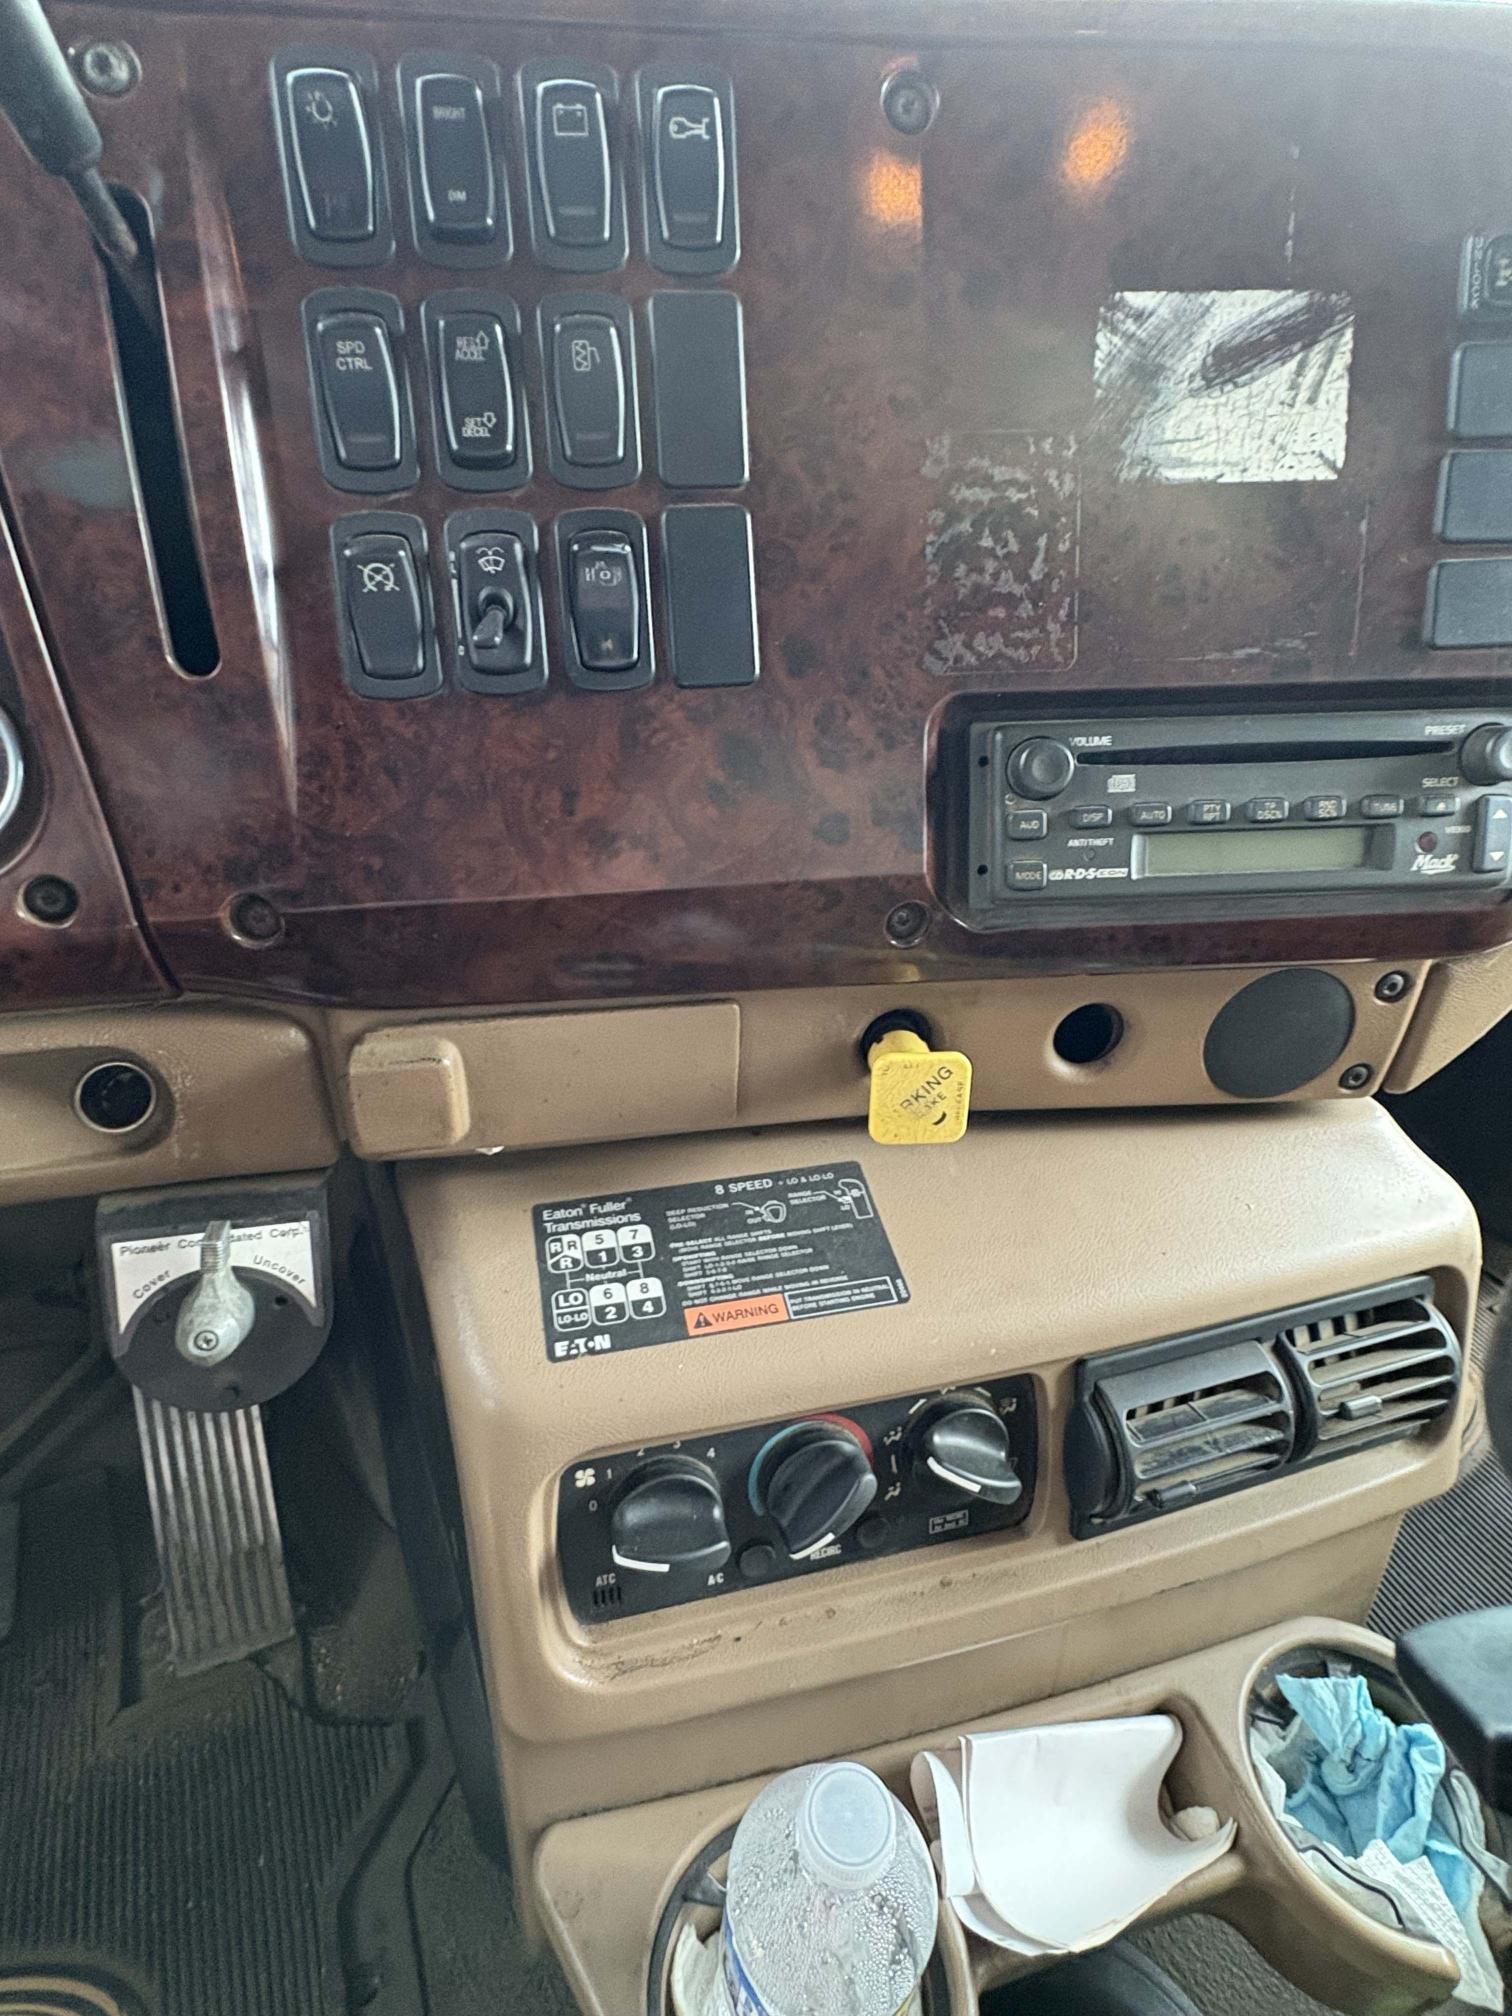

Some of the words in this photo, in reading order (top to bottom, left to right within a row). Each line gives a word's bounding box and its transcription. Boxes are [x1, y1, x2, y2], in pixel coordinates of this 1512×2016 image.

[335, 340, 366, 354] SPD
[335, 357, 374, 371] CTRL
[1425, 724, 1467, 736] PRESET
[1068, 736, 1113, 747] VOLUME
[1421, 776, 1460, 788] SELECT
[1081, 813, 1105, 823] DISP
[1140, 810, 1166, 820] AUTO
[1019, 820, 1040, 830] AUD
[1015, 870, 1042, 880] MODE
[714, 1184, 724, 1195] 8
[728, 1178, 773, 1193] SPEED
[786, 1176, 799, 1185] LO
[543, 1212, 642, 1234] Transmissions
[594, 1233, 605, 1245] 5
[628, 1229, 639, 1240] 7
[119, 1240, 171, 1257] Pioneer
[549, 1241, 563, 1254] R
[567, 1240, 578, 1251] R
[631, 1245, 644, 1258] 3
[597, 1250, 608, 1263] 1
[253, 1254, 307, 1285] Uncover
[559, 1257, 574, 1270] R
[585, 1268, 628, 1282] Neutral
[132, 1269, 171, 1300] Cover
[639, 1282, 650, 1294] 8
[557, 1292, 584, 1307] LO
[603, 1287, 613, 1300] 6
[604, 1306, 618, 1319] 2
[642, 1300, 654, 1313] 4
[711, 1303, 780, 1322] WARNING
[557, 1312, 589, 1325] LO-LO
[706, 1447, 716, 1459] 4
[606, 1468, 613, 1480] 1
[595, 1573, 617, 1588] ATC
